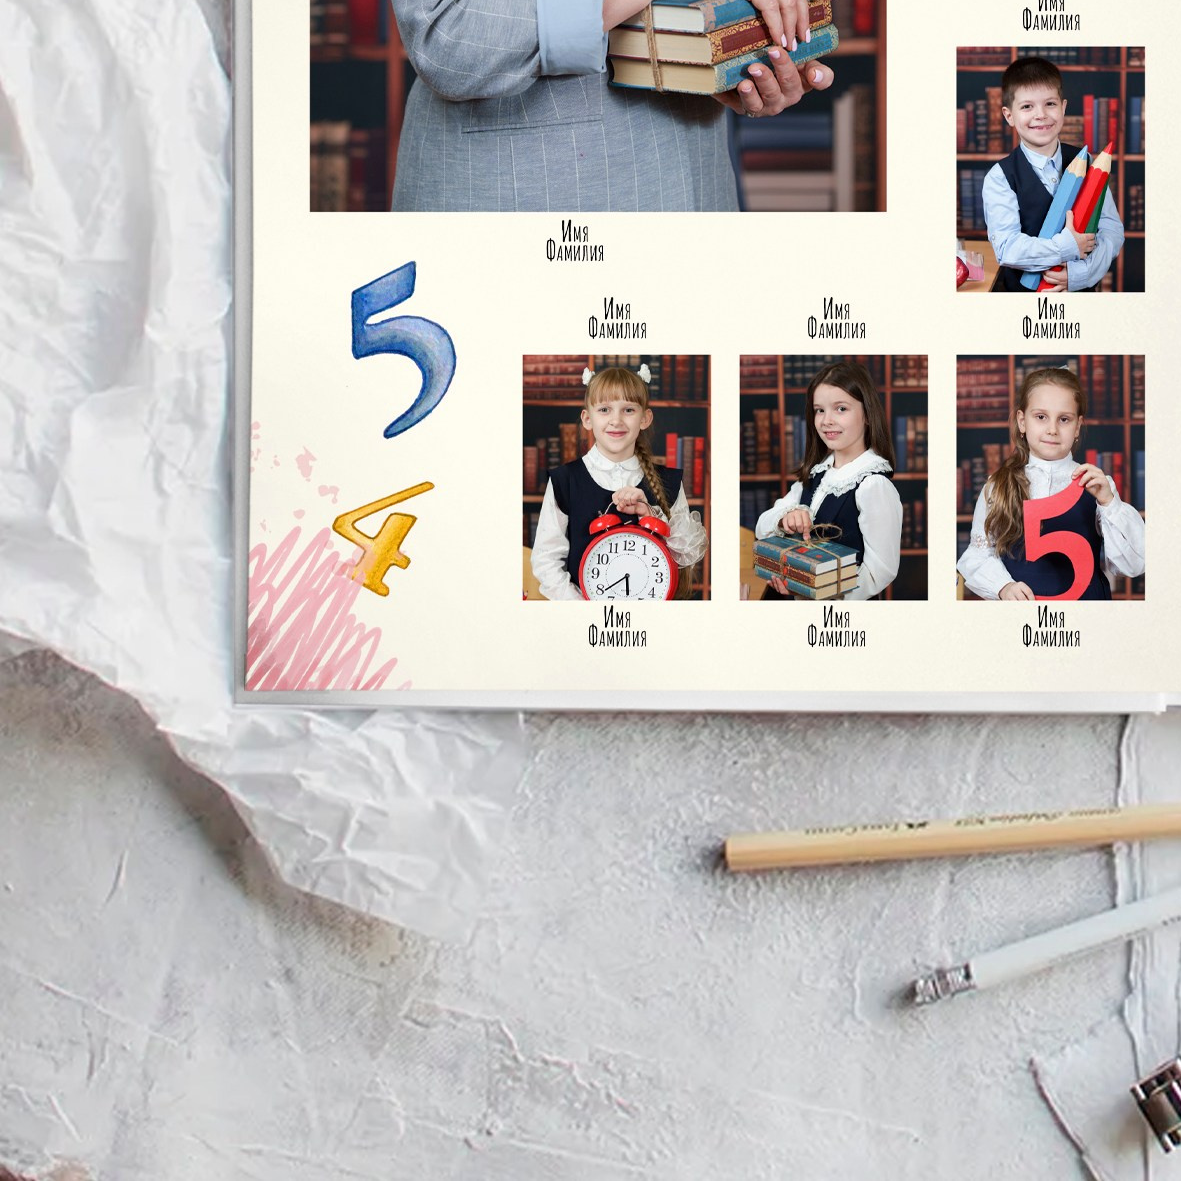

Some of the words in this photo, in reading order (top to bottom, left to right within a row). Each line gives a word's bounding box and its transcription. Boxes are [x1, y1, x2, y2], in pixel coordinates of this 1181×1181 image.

[1022, 6, 1081, 32] Фамилия
[561, 219, 589, 243] Имя
[546, 237, 604, 262] Фамилия
[603, 296, 631, 321] Имя
[823, 296, 850, 321] Имя
[1037, 296, 1065, 321] Имя
[588, 315, 647, 340] Фамилия
[807, 315, 866, 340] Фамилия
[1022, 314, 1081, 340] Фамилия
[351, 260, 457, 439] 5
[331, 481, 435, 597] 4
[608, 542, 619, 554] 11
[623, 540, 636, 551] 12
[1023, 473, 1095, 600] 5
[597, 553, 609, 565] 10
[642, 545, 647, 555] 1
[651, 556, 660, 567] 2
[591, 567, 600, 579] 9
[655, 571, 664, 583] 3
[596, 583, 604, 595] 8
[648, 587, 656, 598] 4
[603, 604, 631, 629] Имя
[823, 604, 850, 629] Имя
[1037, 604, 1065, 629] Имя
[588, 623, 647, 648] Фамилия
[807, 623, 866, 648] Фамилия
[1022, 623, 1081, 648] Фамилия
